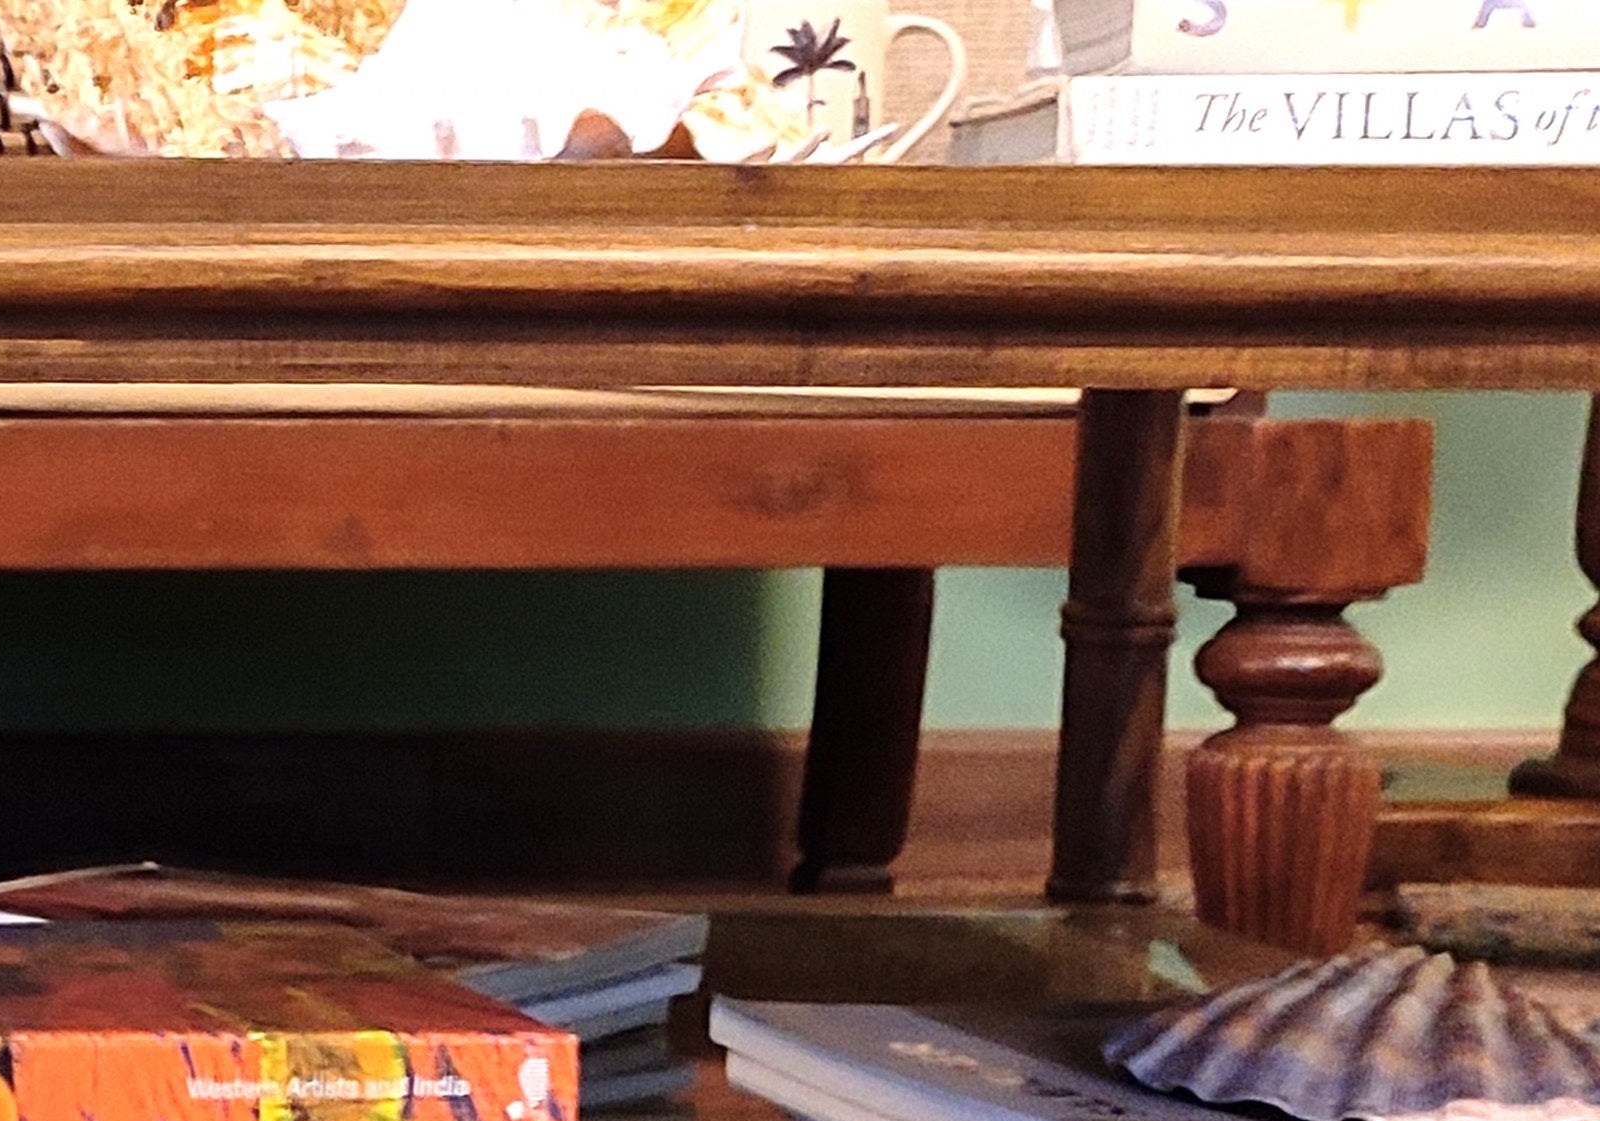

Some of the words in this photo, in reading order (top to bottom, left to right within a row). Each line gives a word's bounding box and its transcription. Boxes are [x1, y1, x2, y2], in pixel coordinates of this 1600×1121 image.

[1195, 91, 1269, 134] The
[1282, 89, 1521, 141] VILLAS
[1534, 88, 1592, 147] of
[186, 1076, 280, 1099] Western
[287, 1076, 360, 1098] Artists
[365, 1076, 411, 1097] and
[413, 1075, 472, 1097] India
